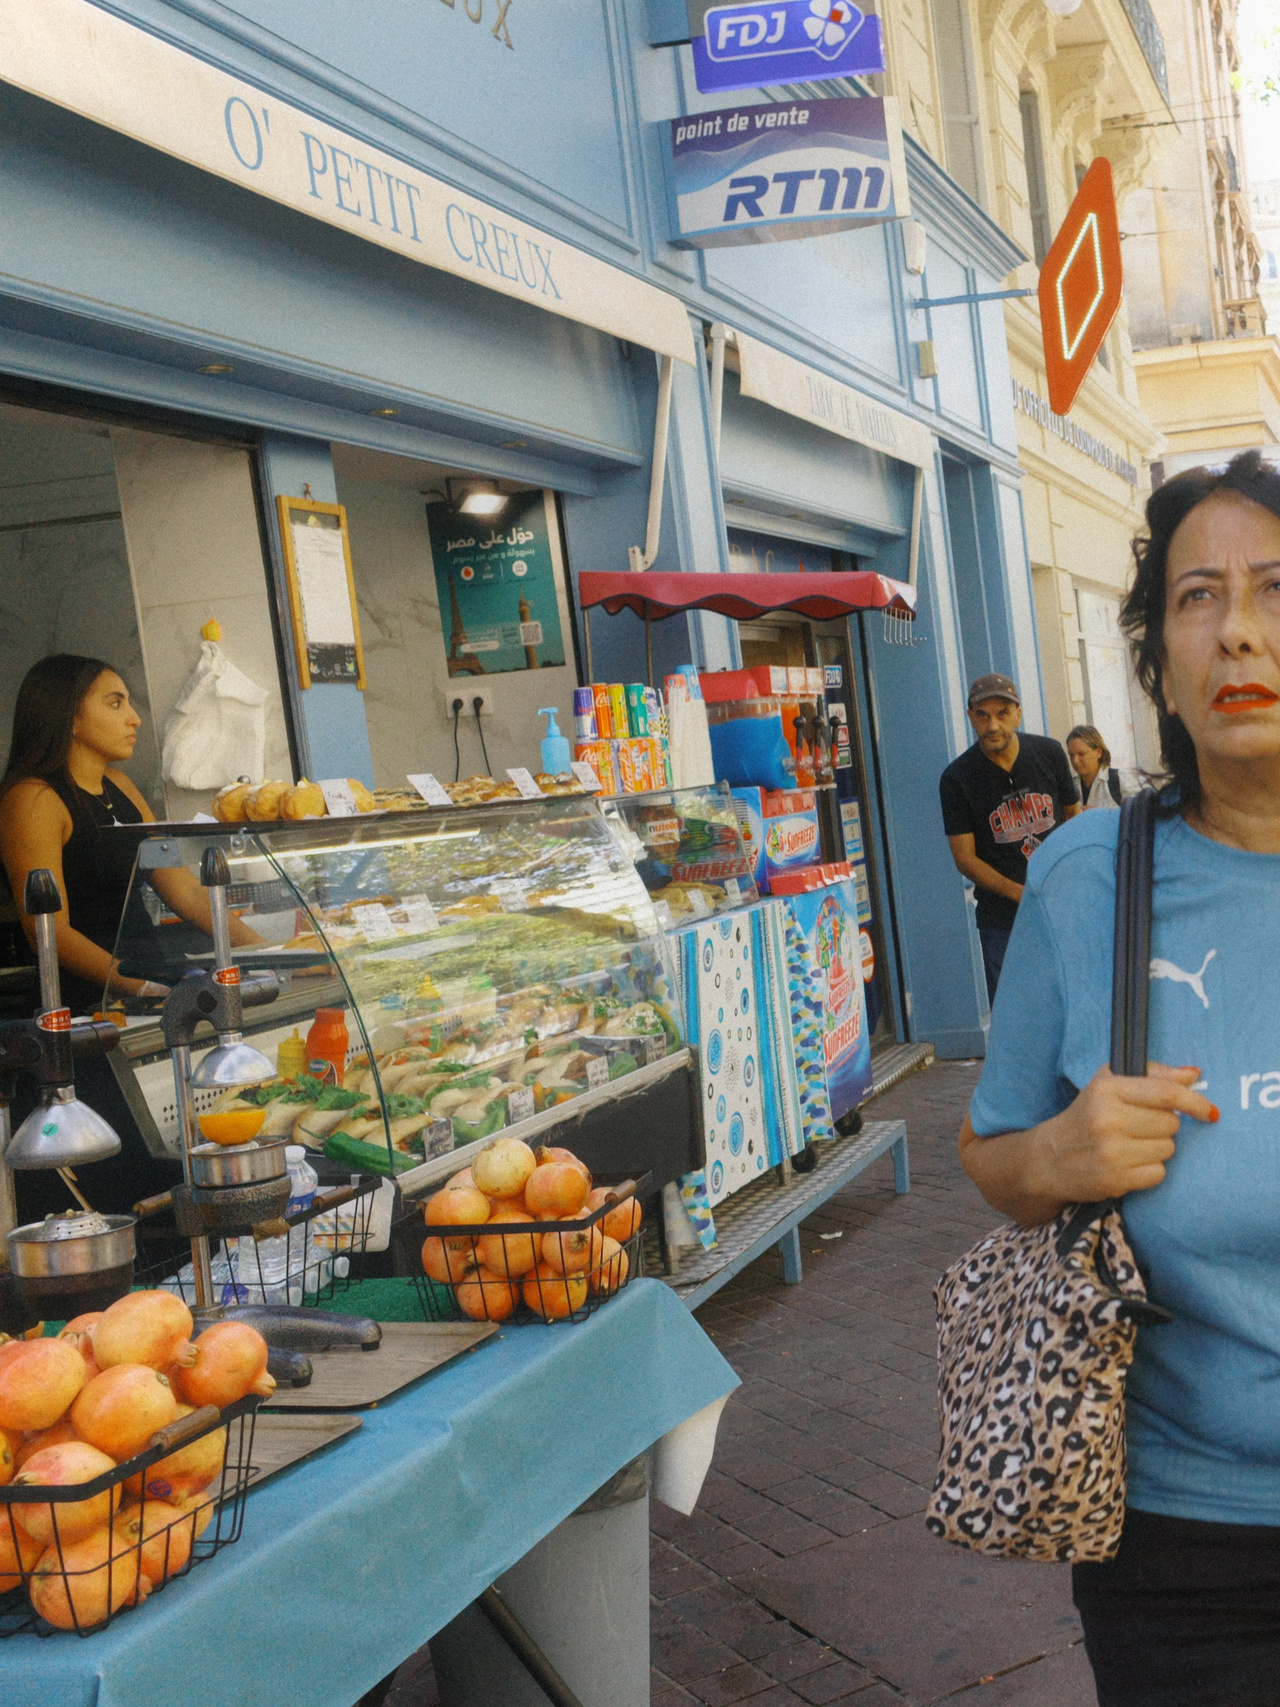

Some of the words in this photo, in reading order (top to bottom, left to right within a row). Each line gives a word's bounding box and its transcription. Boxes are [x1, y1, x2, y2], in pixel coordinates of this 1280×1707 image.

[716, 11, 786, 51] FDJ
[676, 114, 723, 144] point
[727, 111, 750, 132] de
[754, 107, 810, 129] vente
[224, 96, 271, 171] O'
[300, 130, 425, 244] PETIT
[445, 203, 563, 301] CREUX
[723, 167, 885, 222] RTM
[446, 537, 476, 552] مصر
[479, 530, 504, 549] على
[989, 792, 1053, 834] CHAMPS
[823, 1012, 860, 1064] SUNFREEZE
